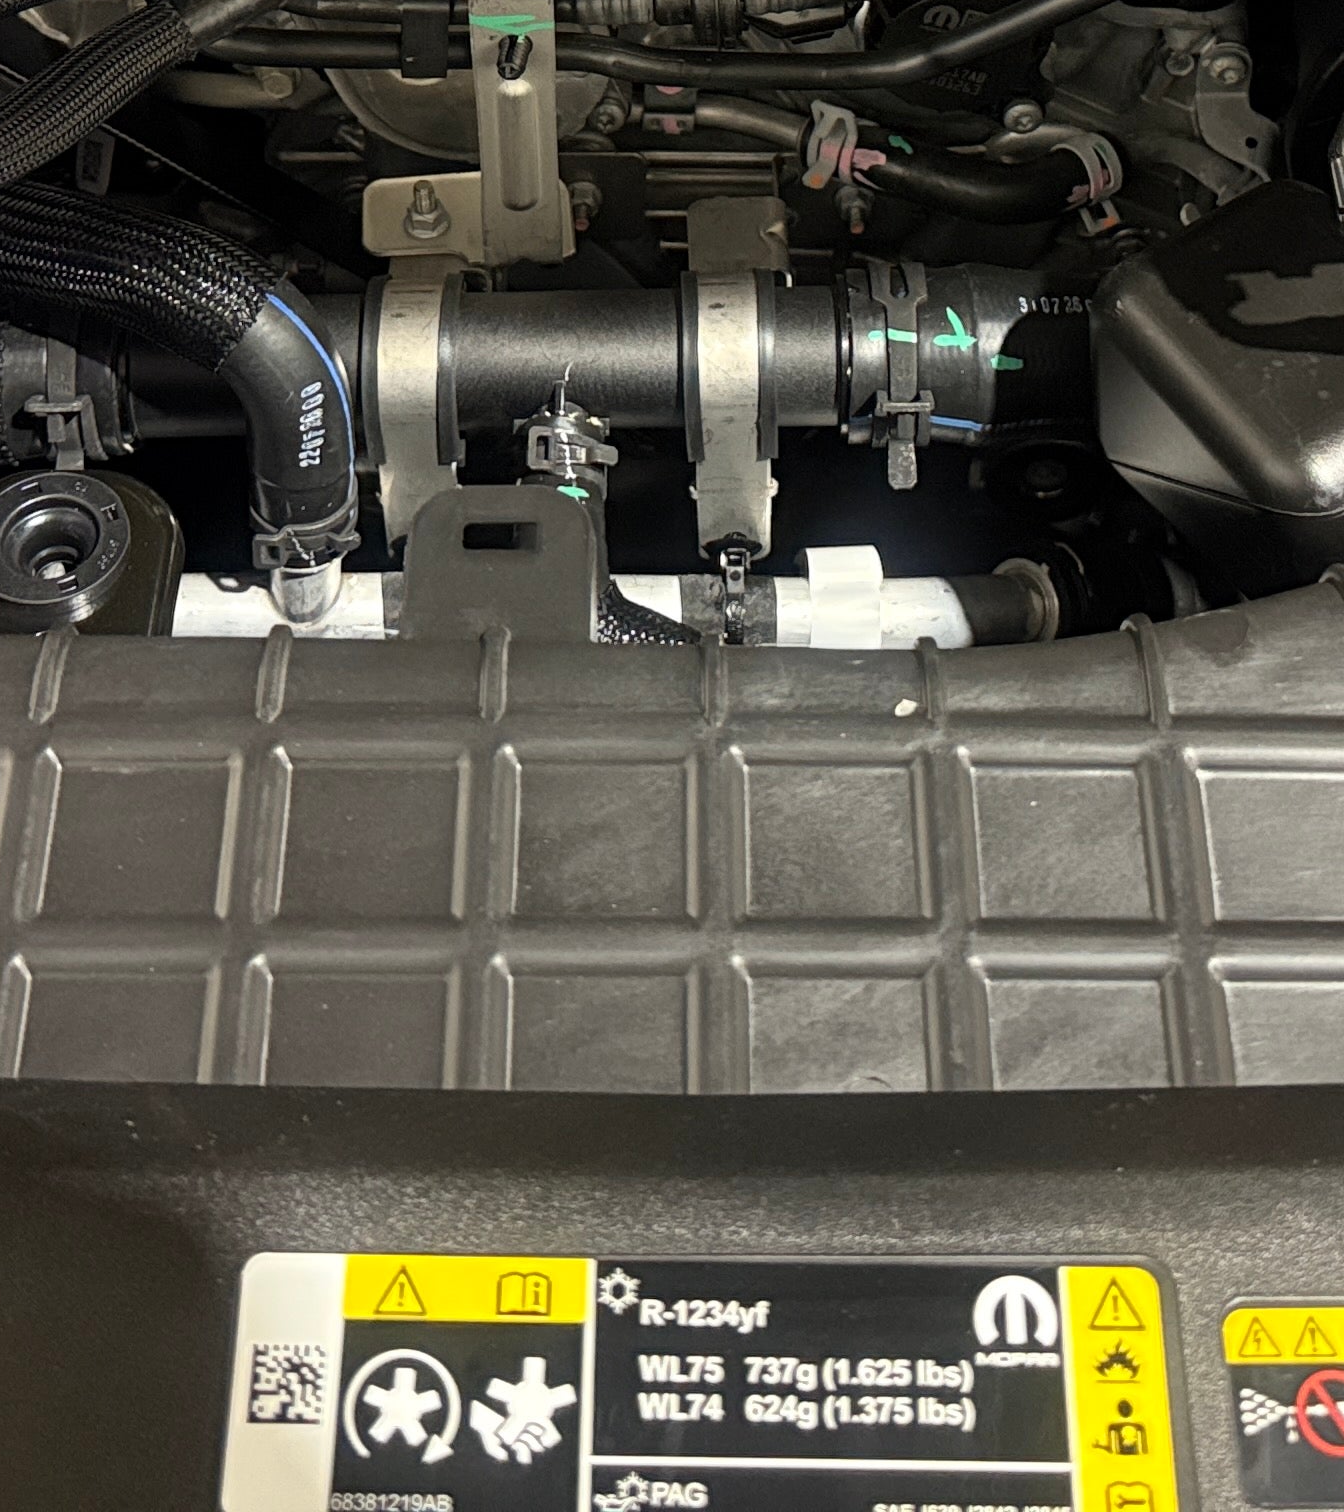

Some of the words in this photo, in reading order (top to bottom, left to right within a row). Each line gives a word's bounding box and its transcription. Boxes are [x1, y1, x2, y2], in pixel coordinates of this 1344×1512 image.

[639, 1299, 771, 1334] R-1234yf
[639, 1355, 725, 1384] WL75
[744, 1357, 818, 1391] 737g
[823, 1358, 913, 1392] (1.625
[916, 1359, 975, 1394] lbs)
[638, 1393, 725, 1422] WL74
[743, 1397, 818, 1430] 624g
[823, 1397, 915, 1431] (1.375
[917, 1398, 977, 1432] lbs)
[330, 1492, 453, 1512] 68381219AB
[650, 1481, 709, 1508] PAG
